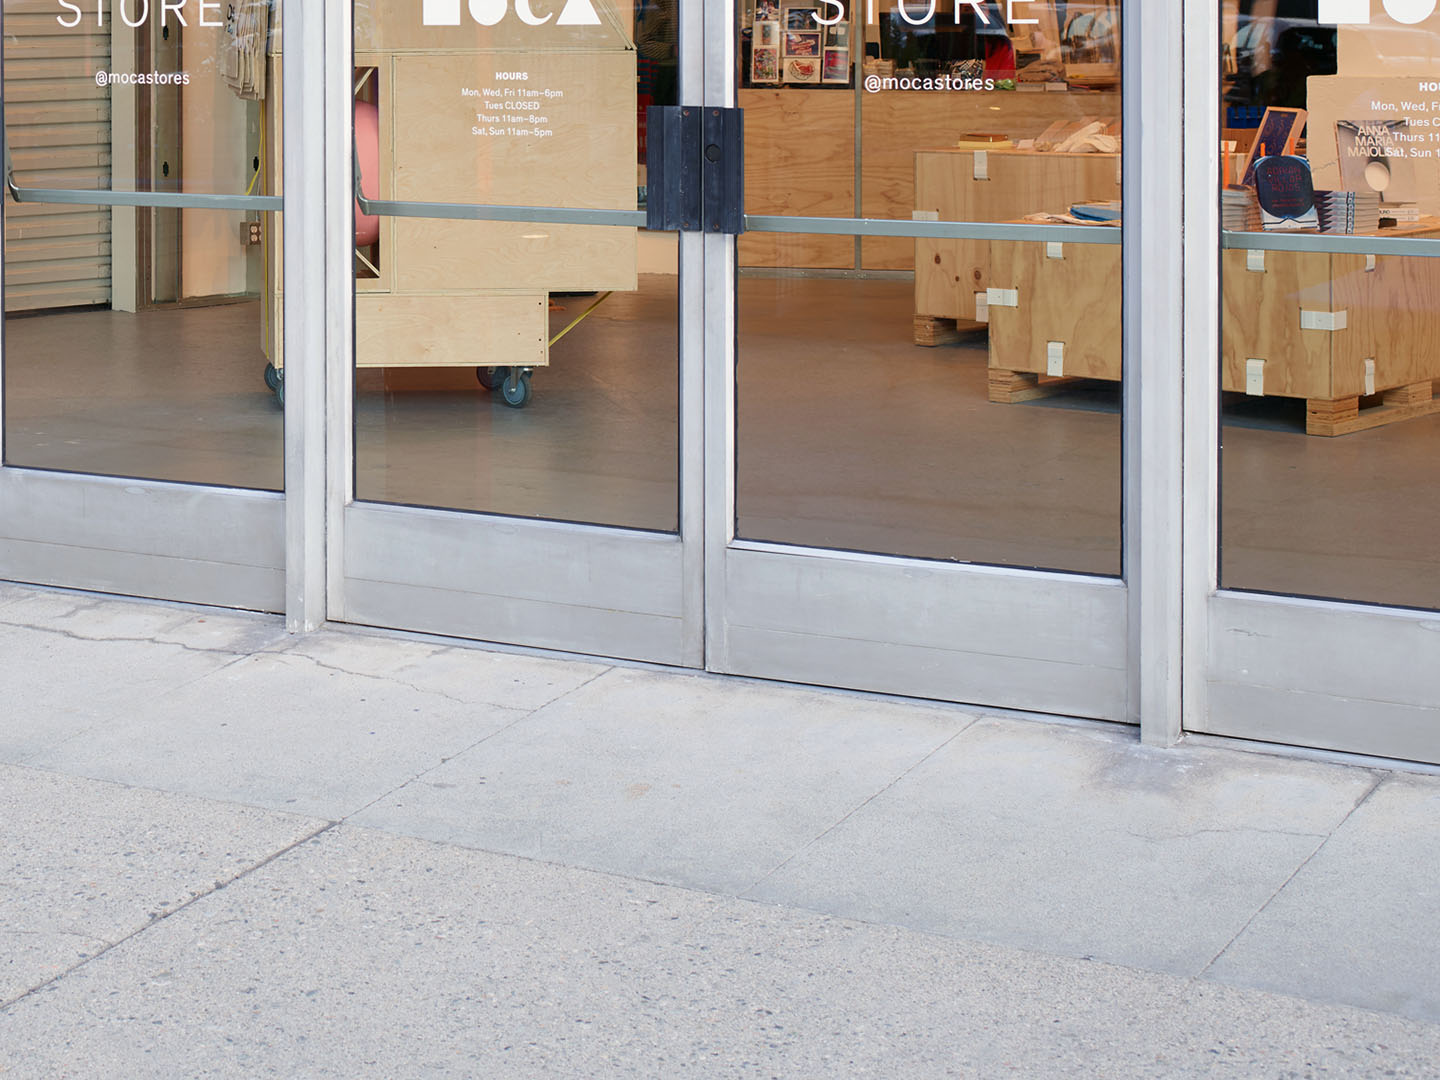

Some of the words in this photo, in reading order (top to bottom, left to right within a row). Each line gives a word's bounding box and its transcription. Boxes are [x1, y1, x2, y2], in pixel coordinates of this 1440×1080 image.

[95, 70, 190, 87] @mocastores
[495, 72, 529, 81] HOURS
[864, 74, 995, 93] @mocastores
[461, 88, 481, 98] Mon,
[482, 88, 503, 98] Wed,
[504, 88, 516, 97] Fri
[484, 101, 503, 110] Tues
[504, 101, 540, 110] CLOSED
[1370, 100, 1399, 112] Mon,
[1400, 101, 1429, 112] Wed,
[477, 114, 500, 123] Thurs
[1403, 117, 1430, 127] Tues
[472, 127, 488, 137] Sat,
[489, 127, 505, 136] Sun
[1358, 125, 1390, 136] ANNA
[1355, 136, 1394, 146] MARIA
[1392, 131, 1425, 142] Thurs
[1410, 147, 1432, 158] Sun
